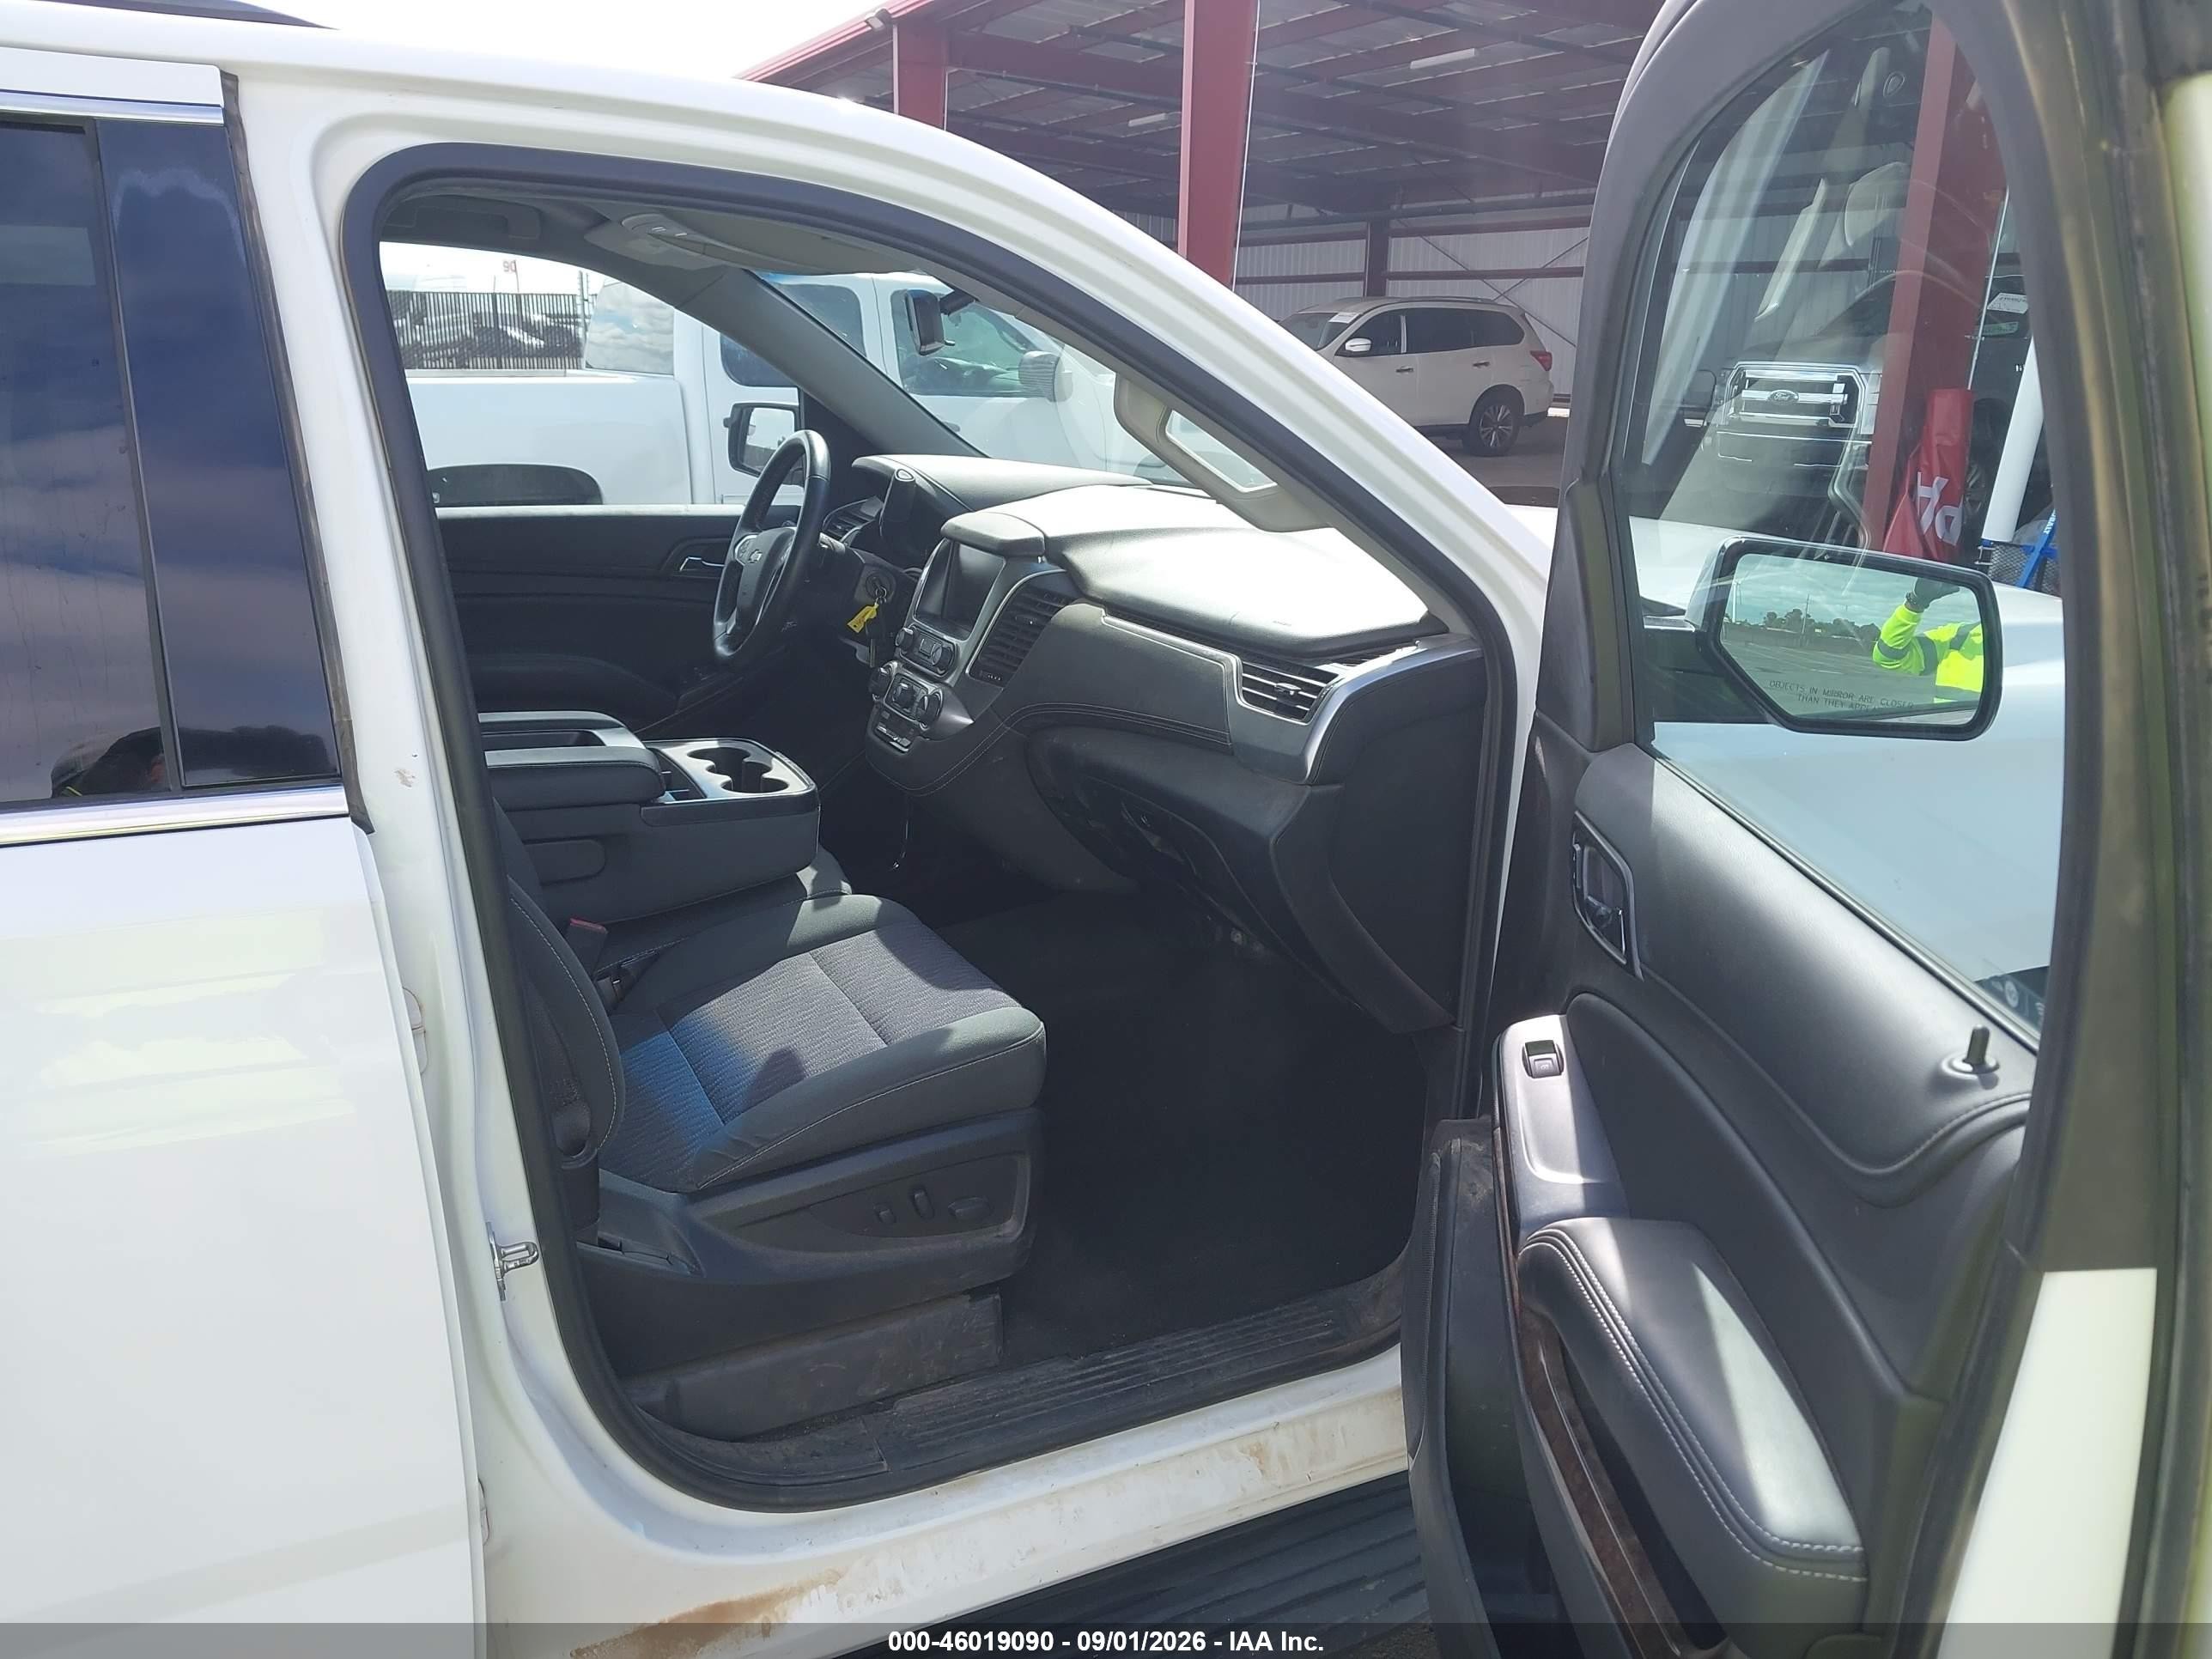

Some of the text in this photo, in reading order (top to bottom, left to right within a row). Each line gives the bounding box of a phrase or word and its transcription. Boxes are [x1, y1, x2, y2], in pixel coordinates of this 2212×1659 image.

[1769, 679, 1915, 709] OBJECTS IN MIRROR ARE CLOSER
[1798, 693, 1880, 712] THAN THEY APPEA
